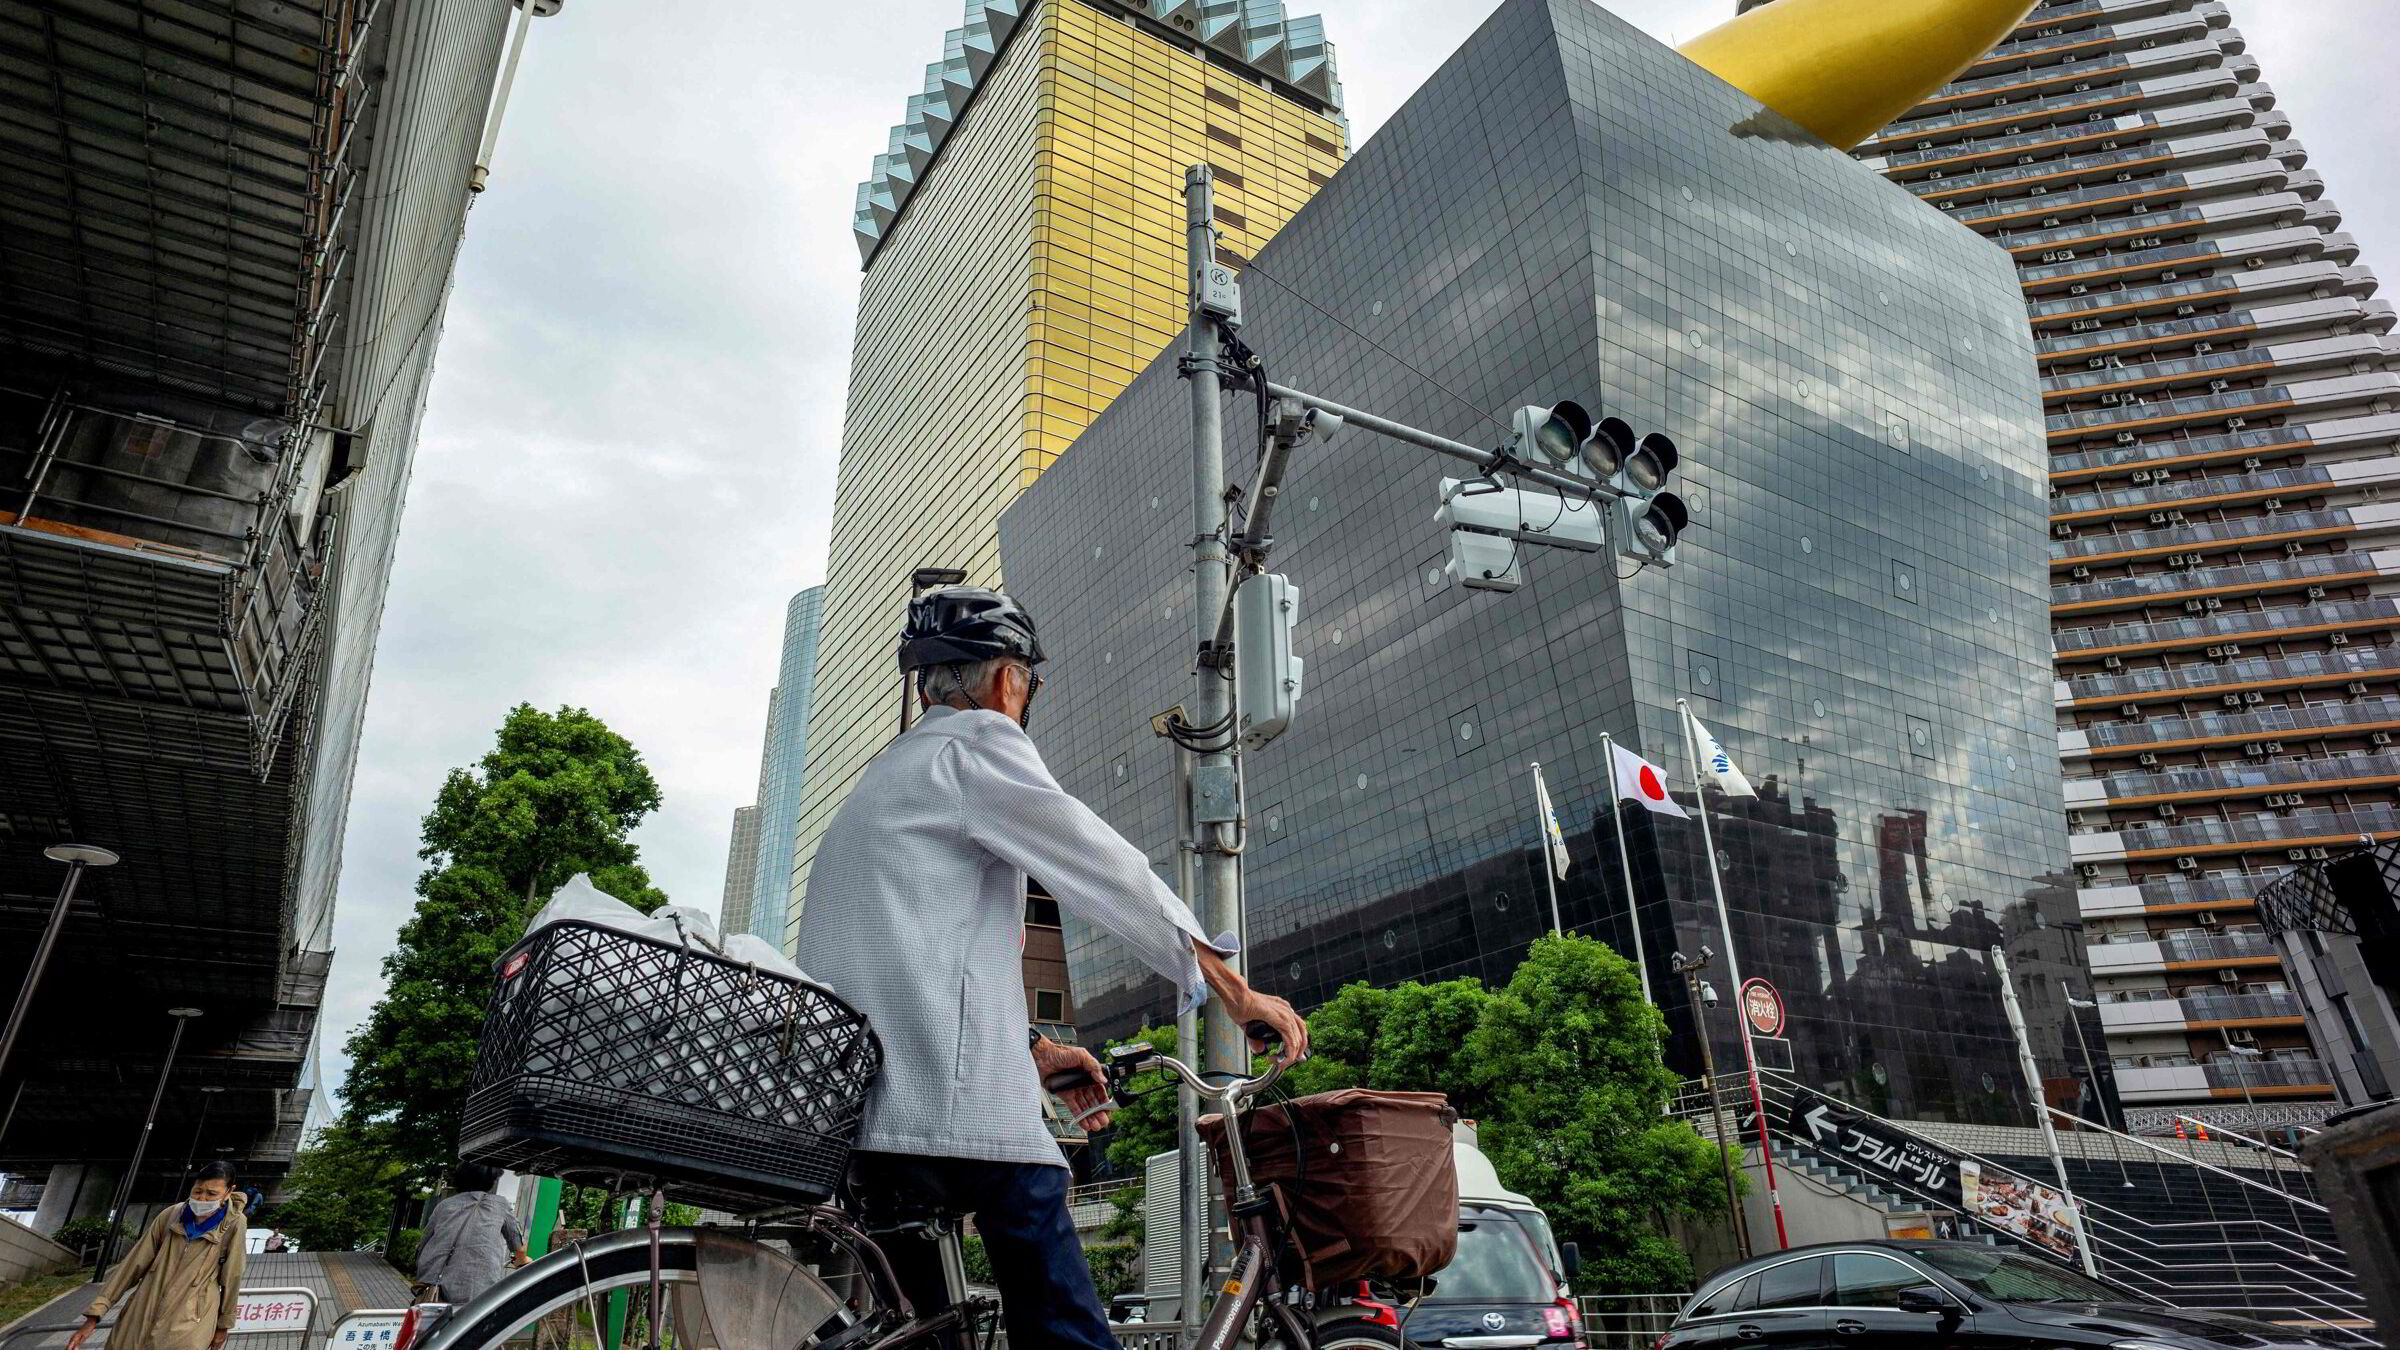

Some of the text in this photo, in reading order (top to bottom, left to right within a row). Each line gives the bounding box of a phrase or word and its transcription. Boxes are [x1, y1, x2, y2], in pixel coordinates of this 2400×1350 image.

[1748, 998, 1776, 1019] 消火栓
[1841, 1128, 1946, 1189] フラムドール
[345, 1329, 391, 1341] 吾妻橋
[1213, 1299, 1242, 1350] Panasonic
